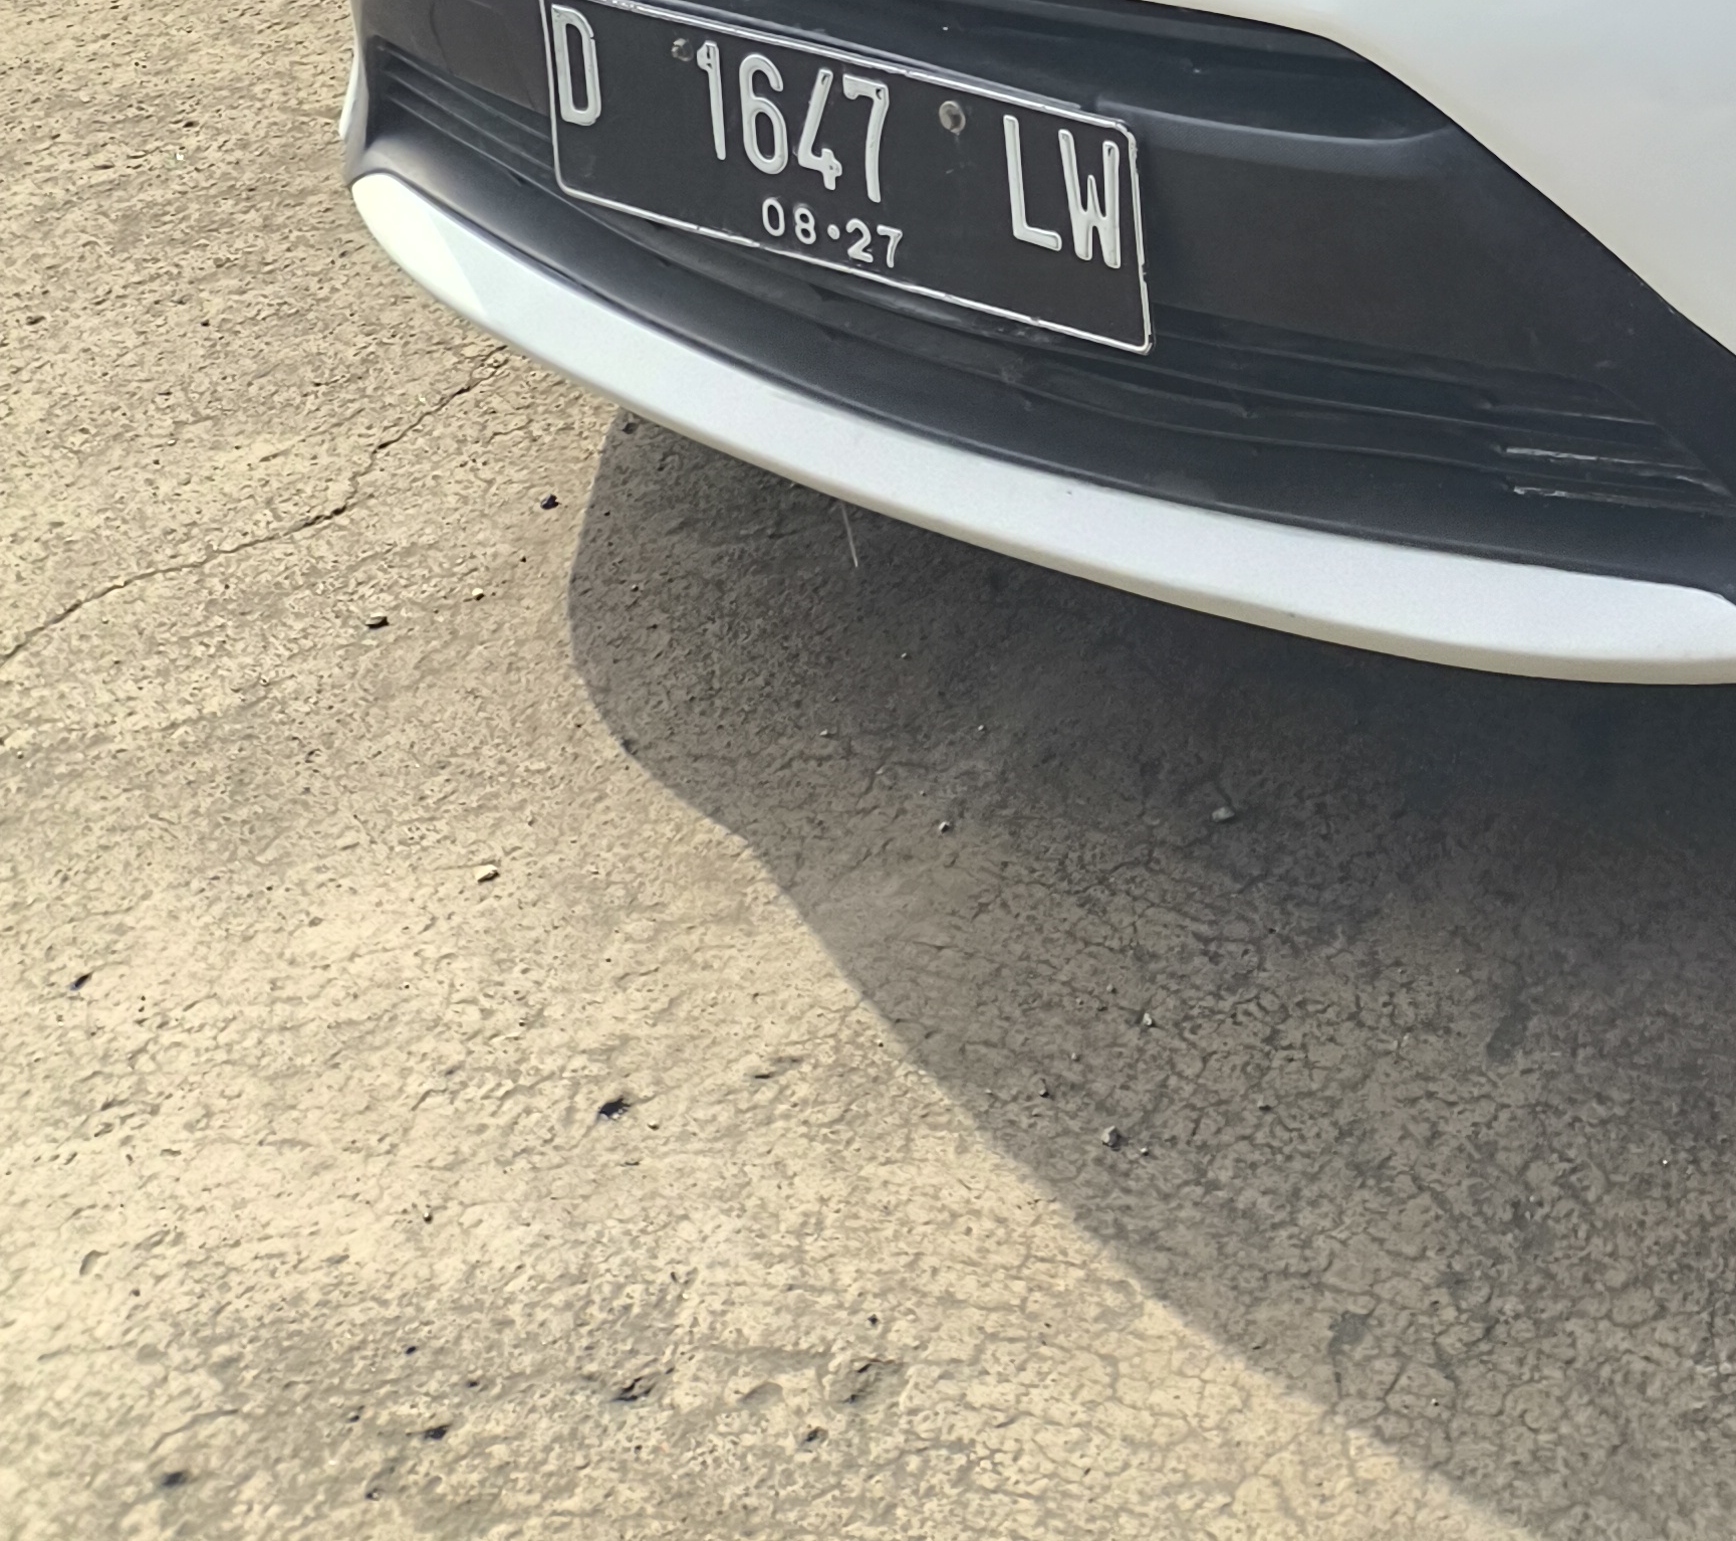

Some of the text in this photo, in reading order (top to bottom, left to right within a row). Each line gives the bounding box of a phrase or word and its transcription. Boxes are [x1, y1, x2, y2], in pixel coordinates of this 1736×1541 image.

[551, 2, 1122, 269] D 1647 LW
